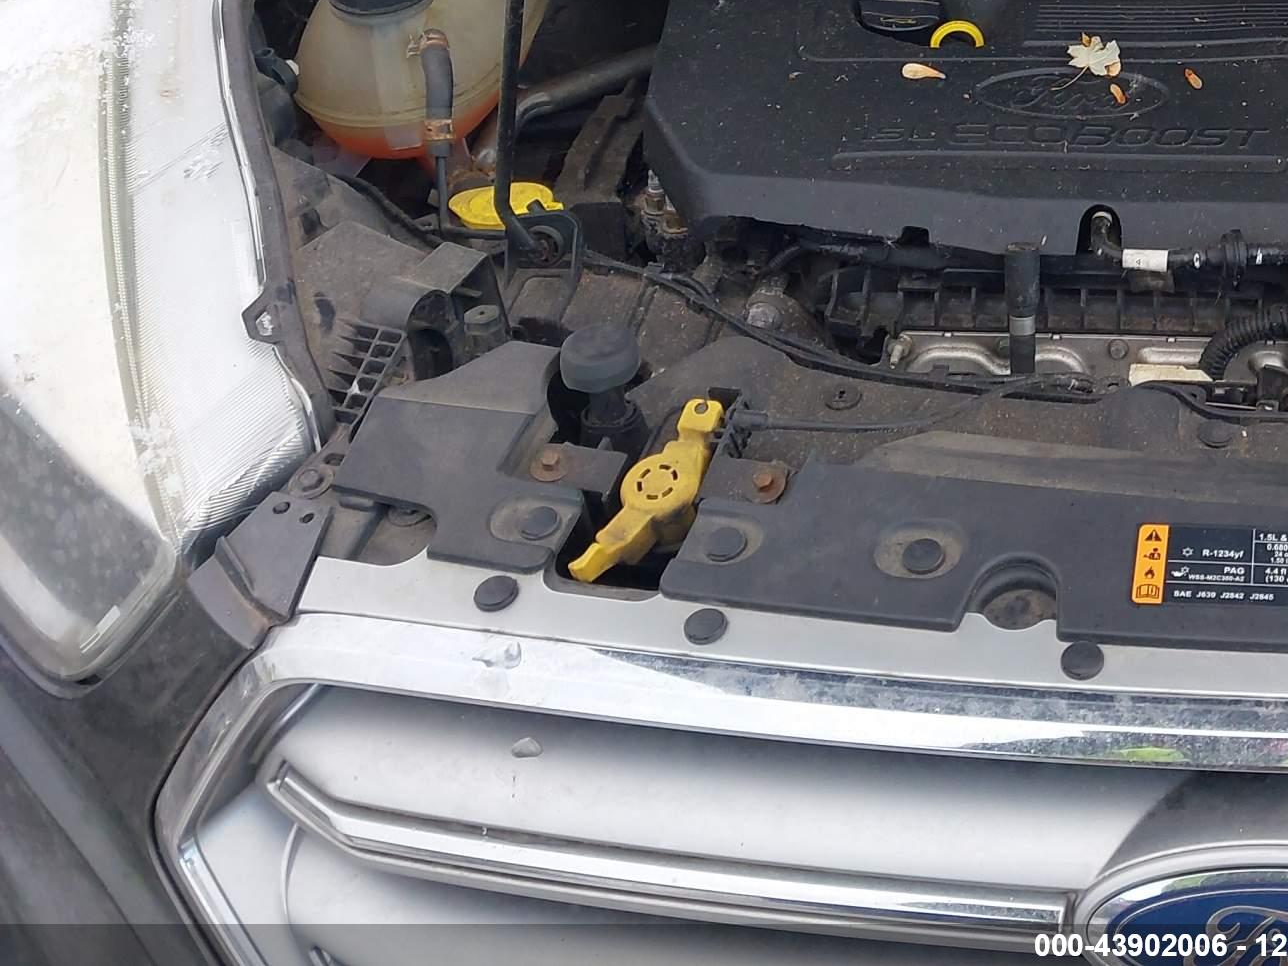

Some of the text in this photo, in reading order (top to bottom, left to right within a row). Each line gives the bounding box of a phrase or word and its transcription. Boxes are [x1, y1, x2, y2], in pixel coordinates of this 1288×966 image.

[947, 122, 1270, 149] ECOBOOST
[1259, 533, 1278, 541] 1.5L
[1202, 549, 1244, 559] R-1234yf
[1223, 566, 1245, 574] PAG
[1265, 567, 1279, 575] 4.4
[1265, 575, 1284, 583] (130
[1173, 590, 1192, 598] SAE
